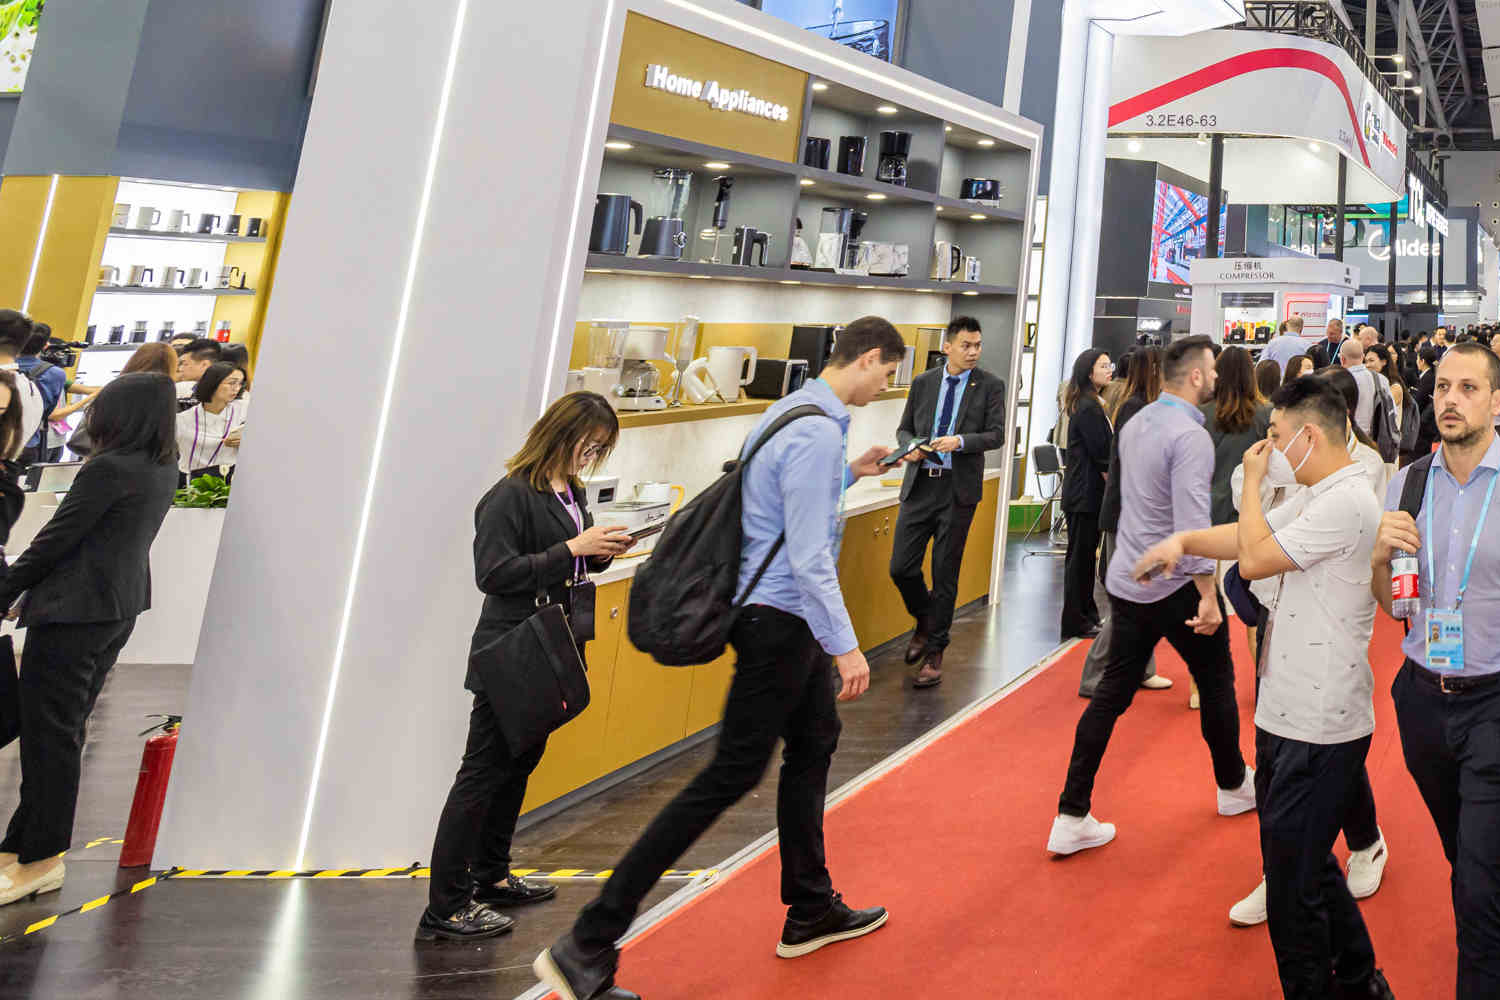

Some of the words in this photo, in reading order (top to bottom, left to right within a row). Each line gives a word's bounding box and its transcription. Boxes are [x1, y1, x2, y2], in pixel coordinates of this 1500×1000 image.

[650, 63, 704, 99] Home
[705, 80, 790, 122] Appliances
[1145, 113, 1218, 128] 3.2E46-63
[1218, 271, 1276, 281] COMPRESSOR
